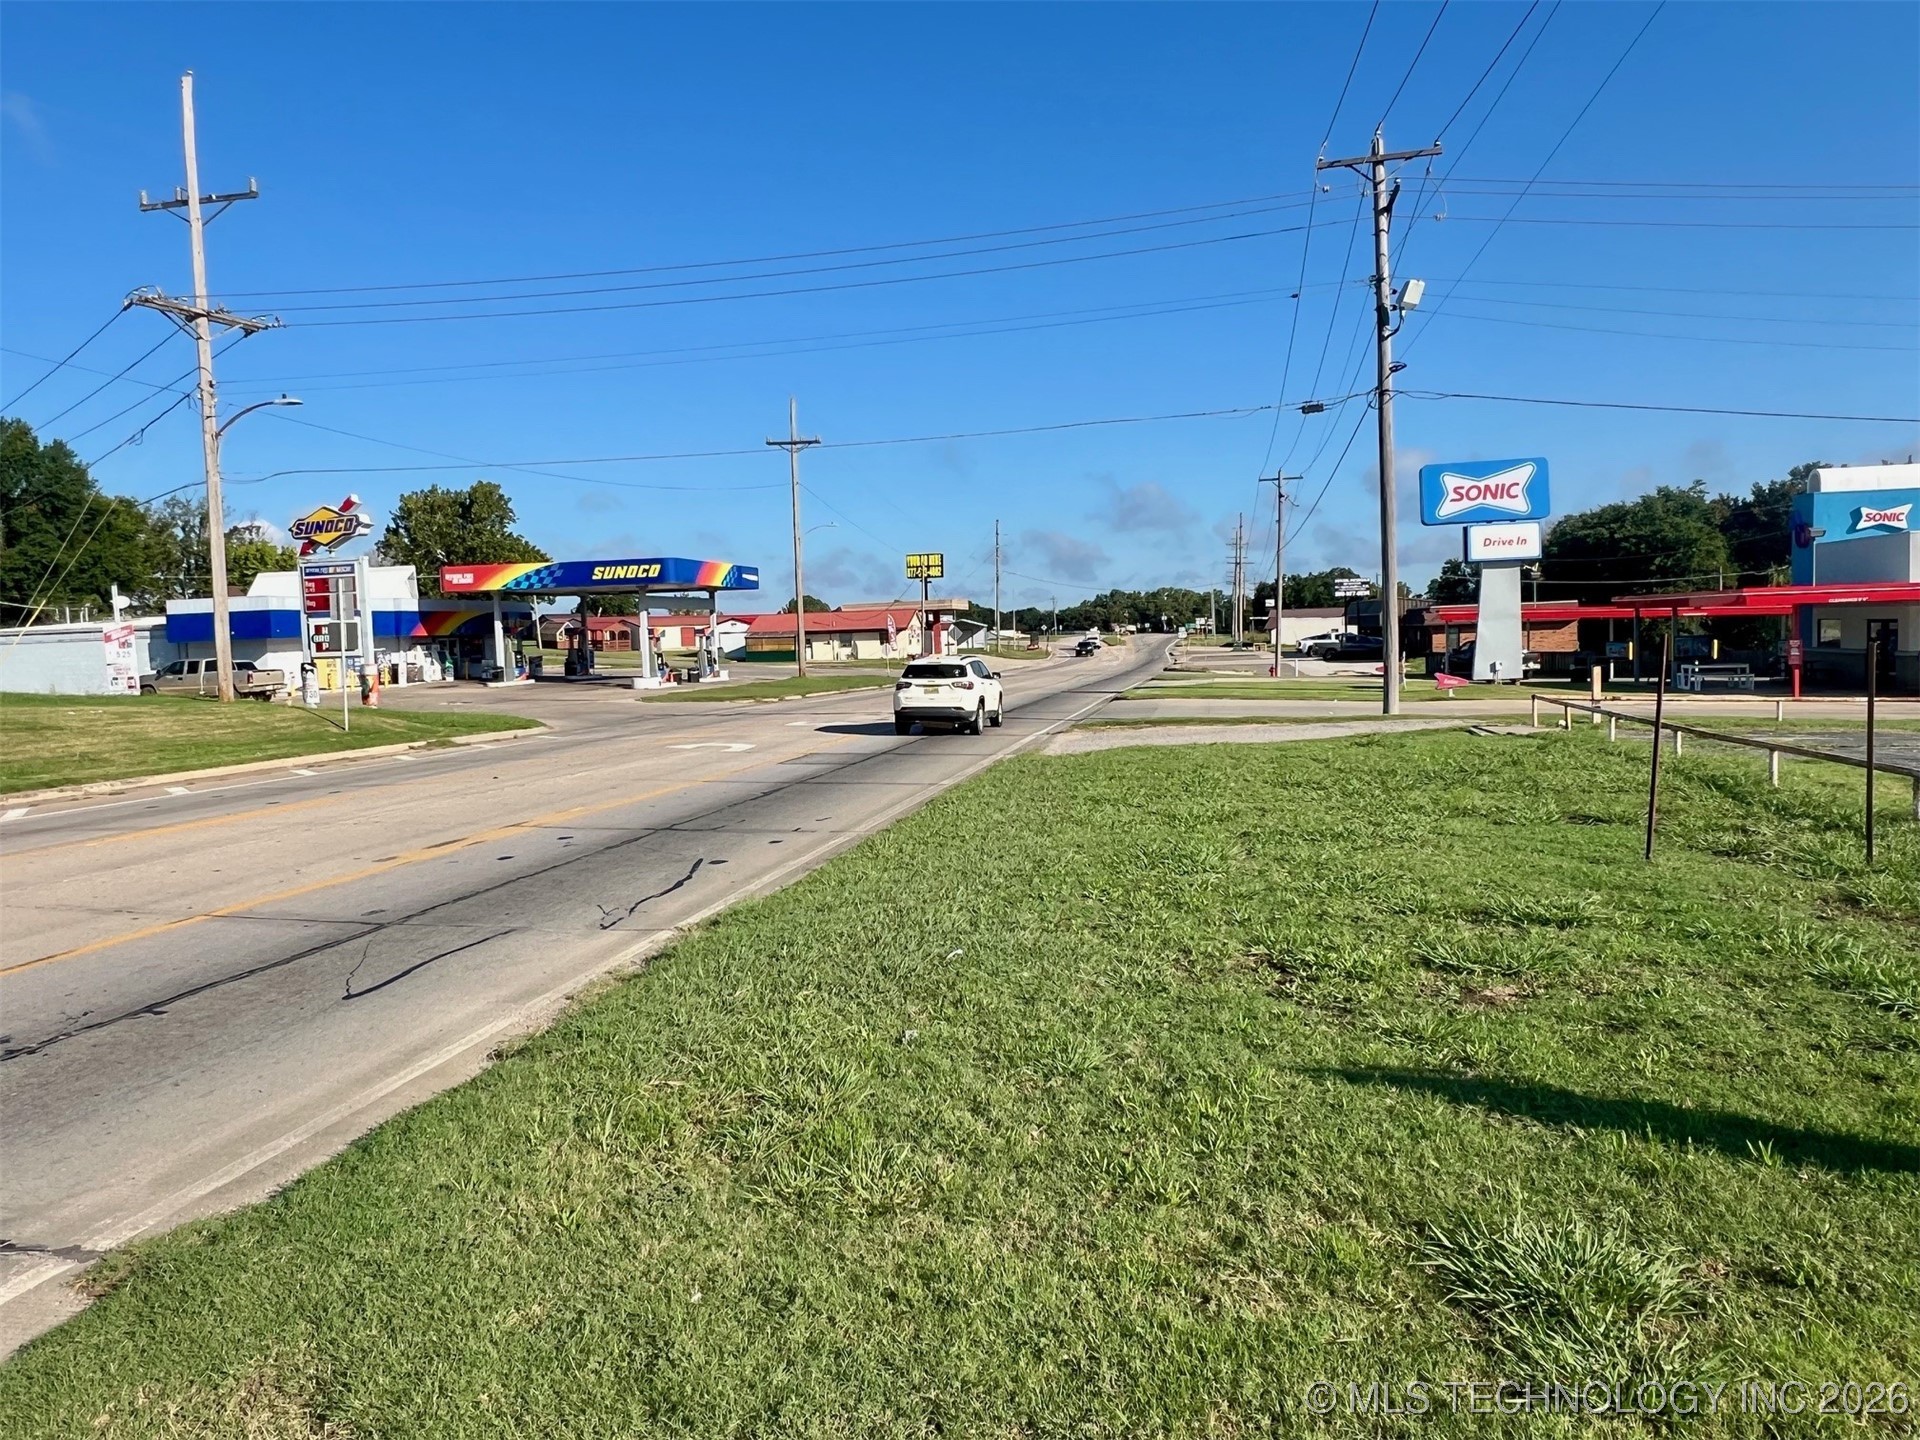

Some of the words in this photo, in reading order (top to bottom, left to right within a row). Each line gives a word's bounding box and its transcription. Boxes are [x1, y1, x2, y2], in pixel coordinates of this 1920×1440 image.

[1450, 482, 1520, 502] SONIC
[1863, 512, 1905, 523] SONIC
[294, 517, 355, 536] SUNOCO
[1483, 537, 1514, 547] Drive
[1516, 535, 1528, 546] In
[907, 555, 920, 567] YOUR
[592, 564, 661, 580] SUNOCO
